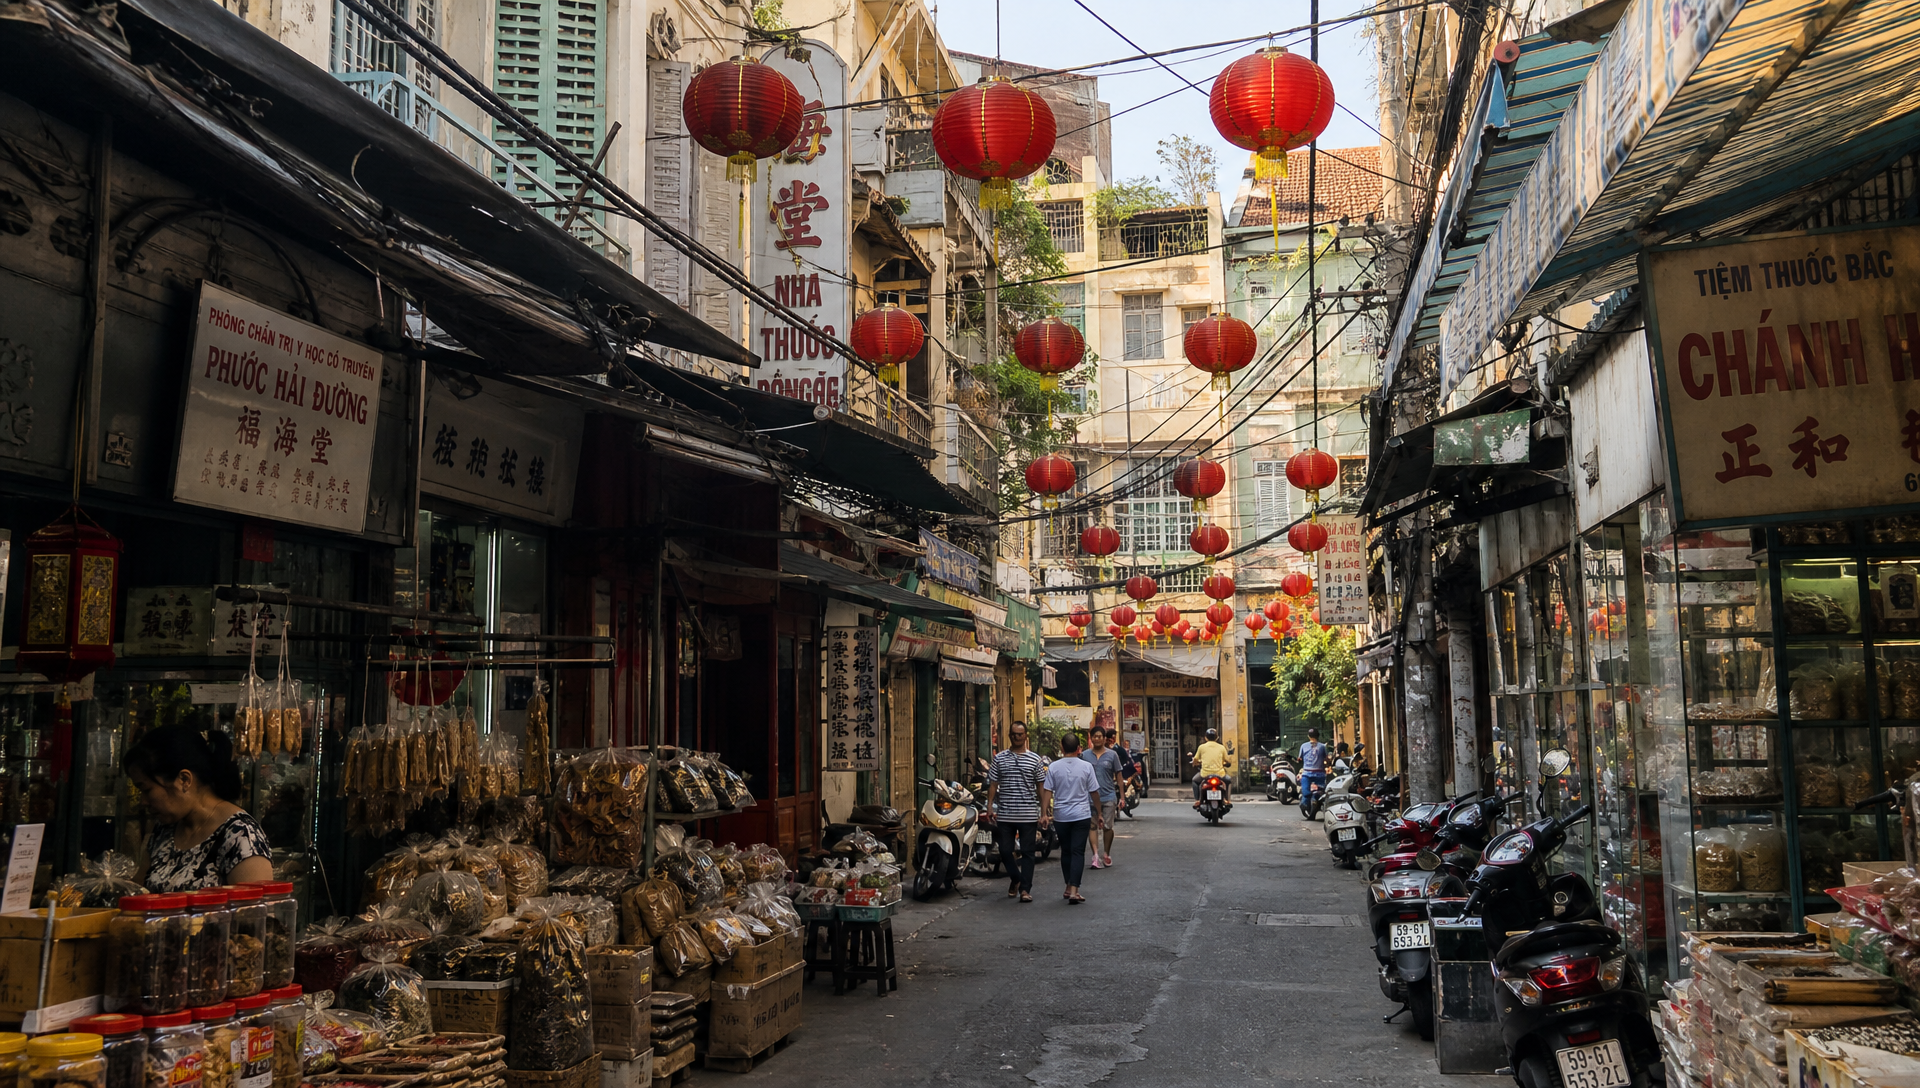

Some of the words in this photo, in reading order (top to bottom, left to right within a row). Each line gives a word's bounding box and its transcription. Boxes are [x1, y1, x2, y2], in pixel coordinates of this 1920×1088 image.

[1693, 261, 1752, 300] TIỆM
[1759, 247, 1838, 290] THUỐC
[1845, 242, 1894, 282] BẮC
[208, 307, 246, 335] PHÒNG
[278, 333, 294, 357] TRỊ
[297, 340, 303, 356] Y
[305, 344, 325, 365] HỌC
[1677, 309, 1869, 401] CHÁNH
[204, 345, 268, 395] PHƯỚC
[273, 362, 307, 407] HẢI
[311, 380, 368, 425] ĐƯỜNG
[235, 405, 333, 466] 福海堂
[1904, 473, 1920, 492] 6
